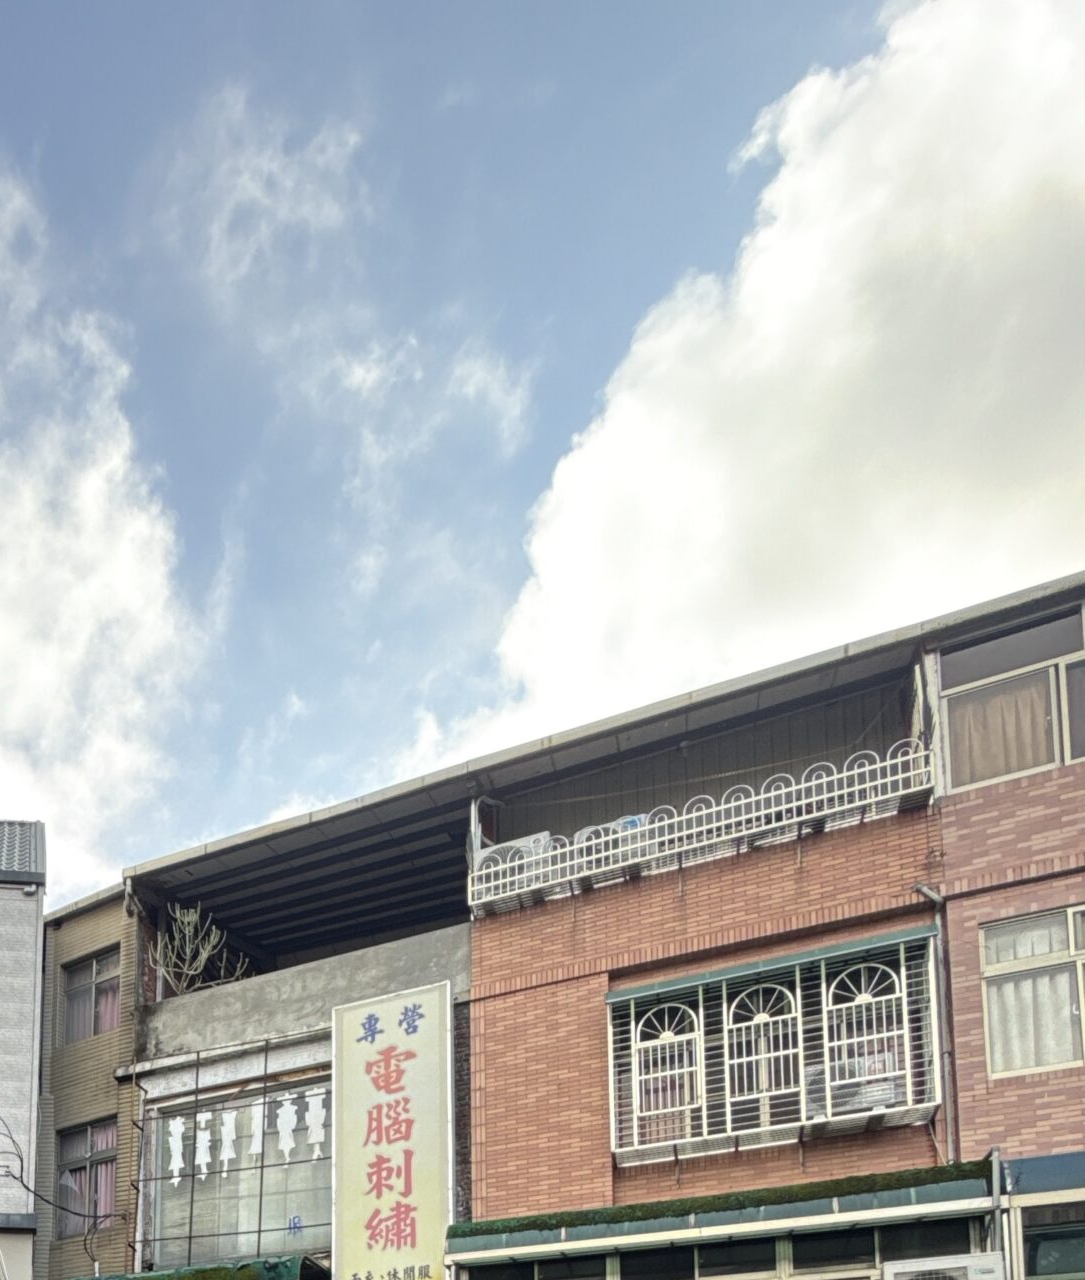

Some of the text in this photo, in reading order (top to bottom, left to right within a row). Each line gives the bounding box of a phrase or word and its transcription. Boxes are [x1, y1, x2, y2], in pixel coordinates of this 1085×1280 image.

[356, 1003, 425, 1044] 專營
[363, 1045, 418, 1251] 電腦刺繡
